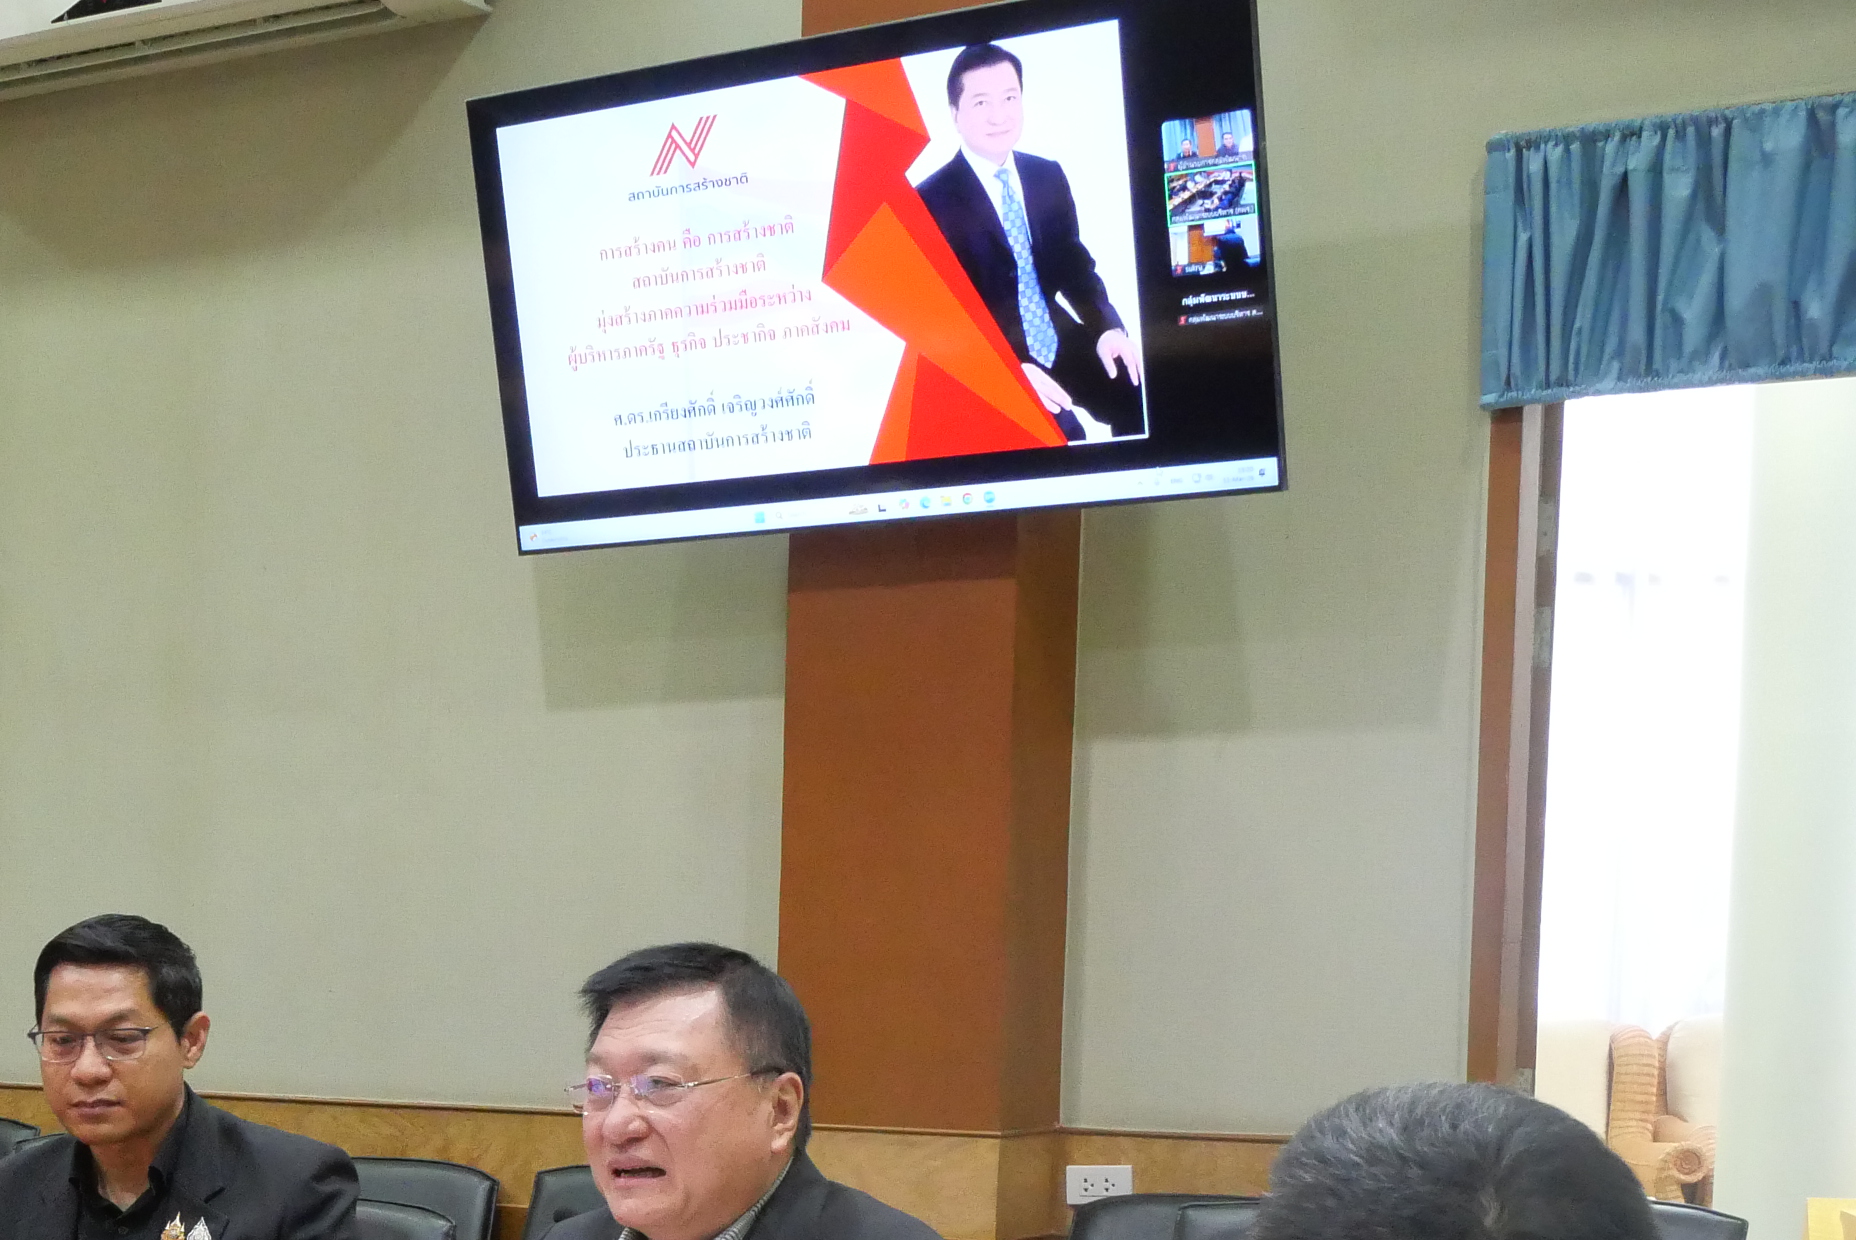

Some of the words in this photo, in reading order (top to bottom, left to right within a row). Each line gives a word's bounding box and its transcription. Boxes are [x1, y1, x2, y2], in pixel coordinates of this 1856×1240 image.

[628, 172, 749, 202] สถาบันการสร้างชาติ
[599, 236, 677, 261] การสร้างคน
[682, 228, 701, 249] คือ
[707, 215, 794, 246] การสร้างชาติ
[632, 253, 766, 289] สถาบันการสร้างชาติ
[567, 337, 665, 372] ผู้บริหารภาครัฐ
[672, 332, 707, 358] ธุรกิจ
[782, 316, 851, 340] ภาคสังคม
[614, 389, 717, 426] ศ.ดร.เกรียงศักดิ์
[721, 378, 816, 417] เจริญวงศ์ศักดิ์
[623, 421, 812, 458] ประธานสถาบันการสร้างชาติ
